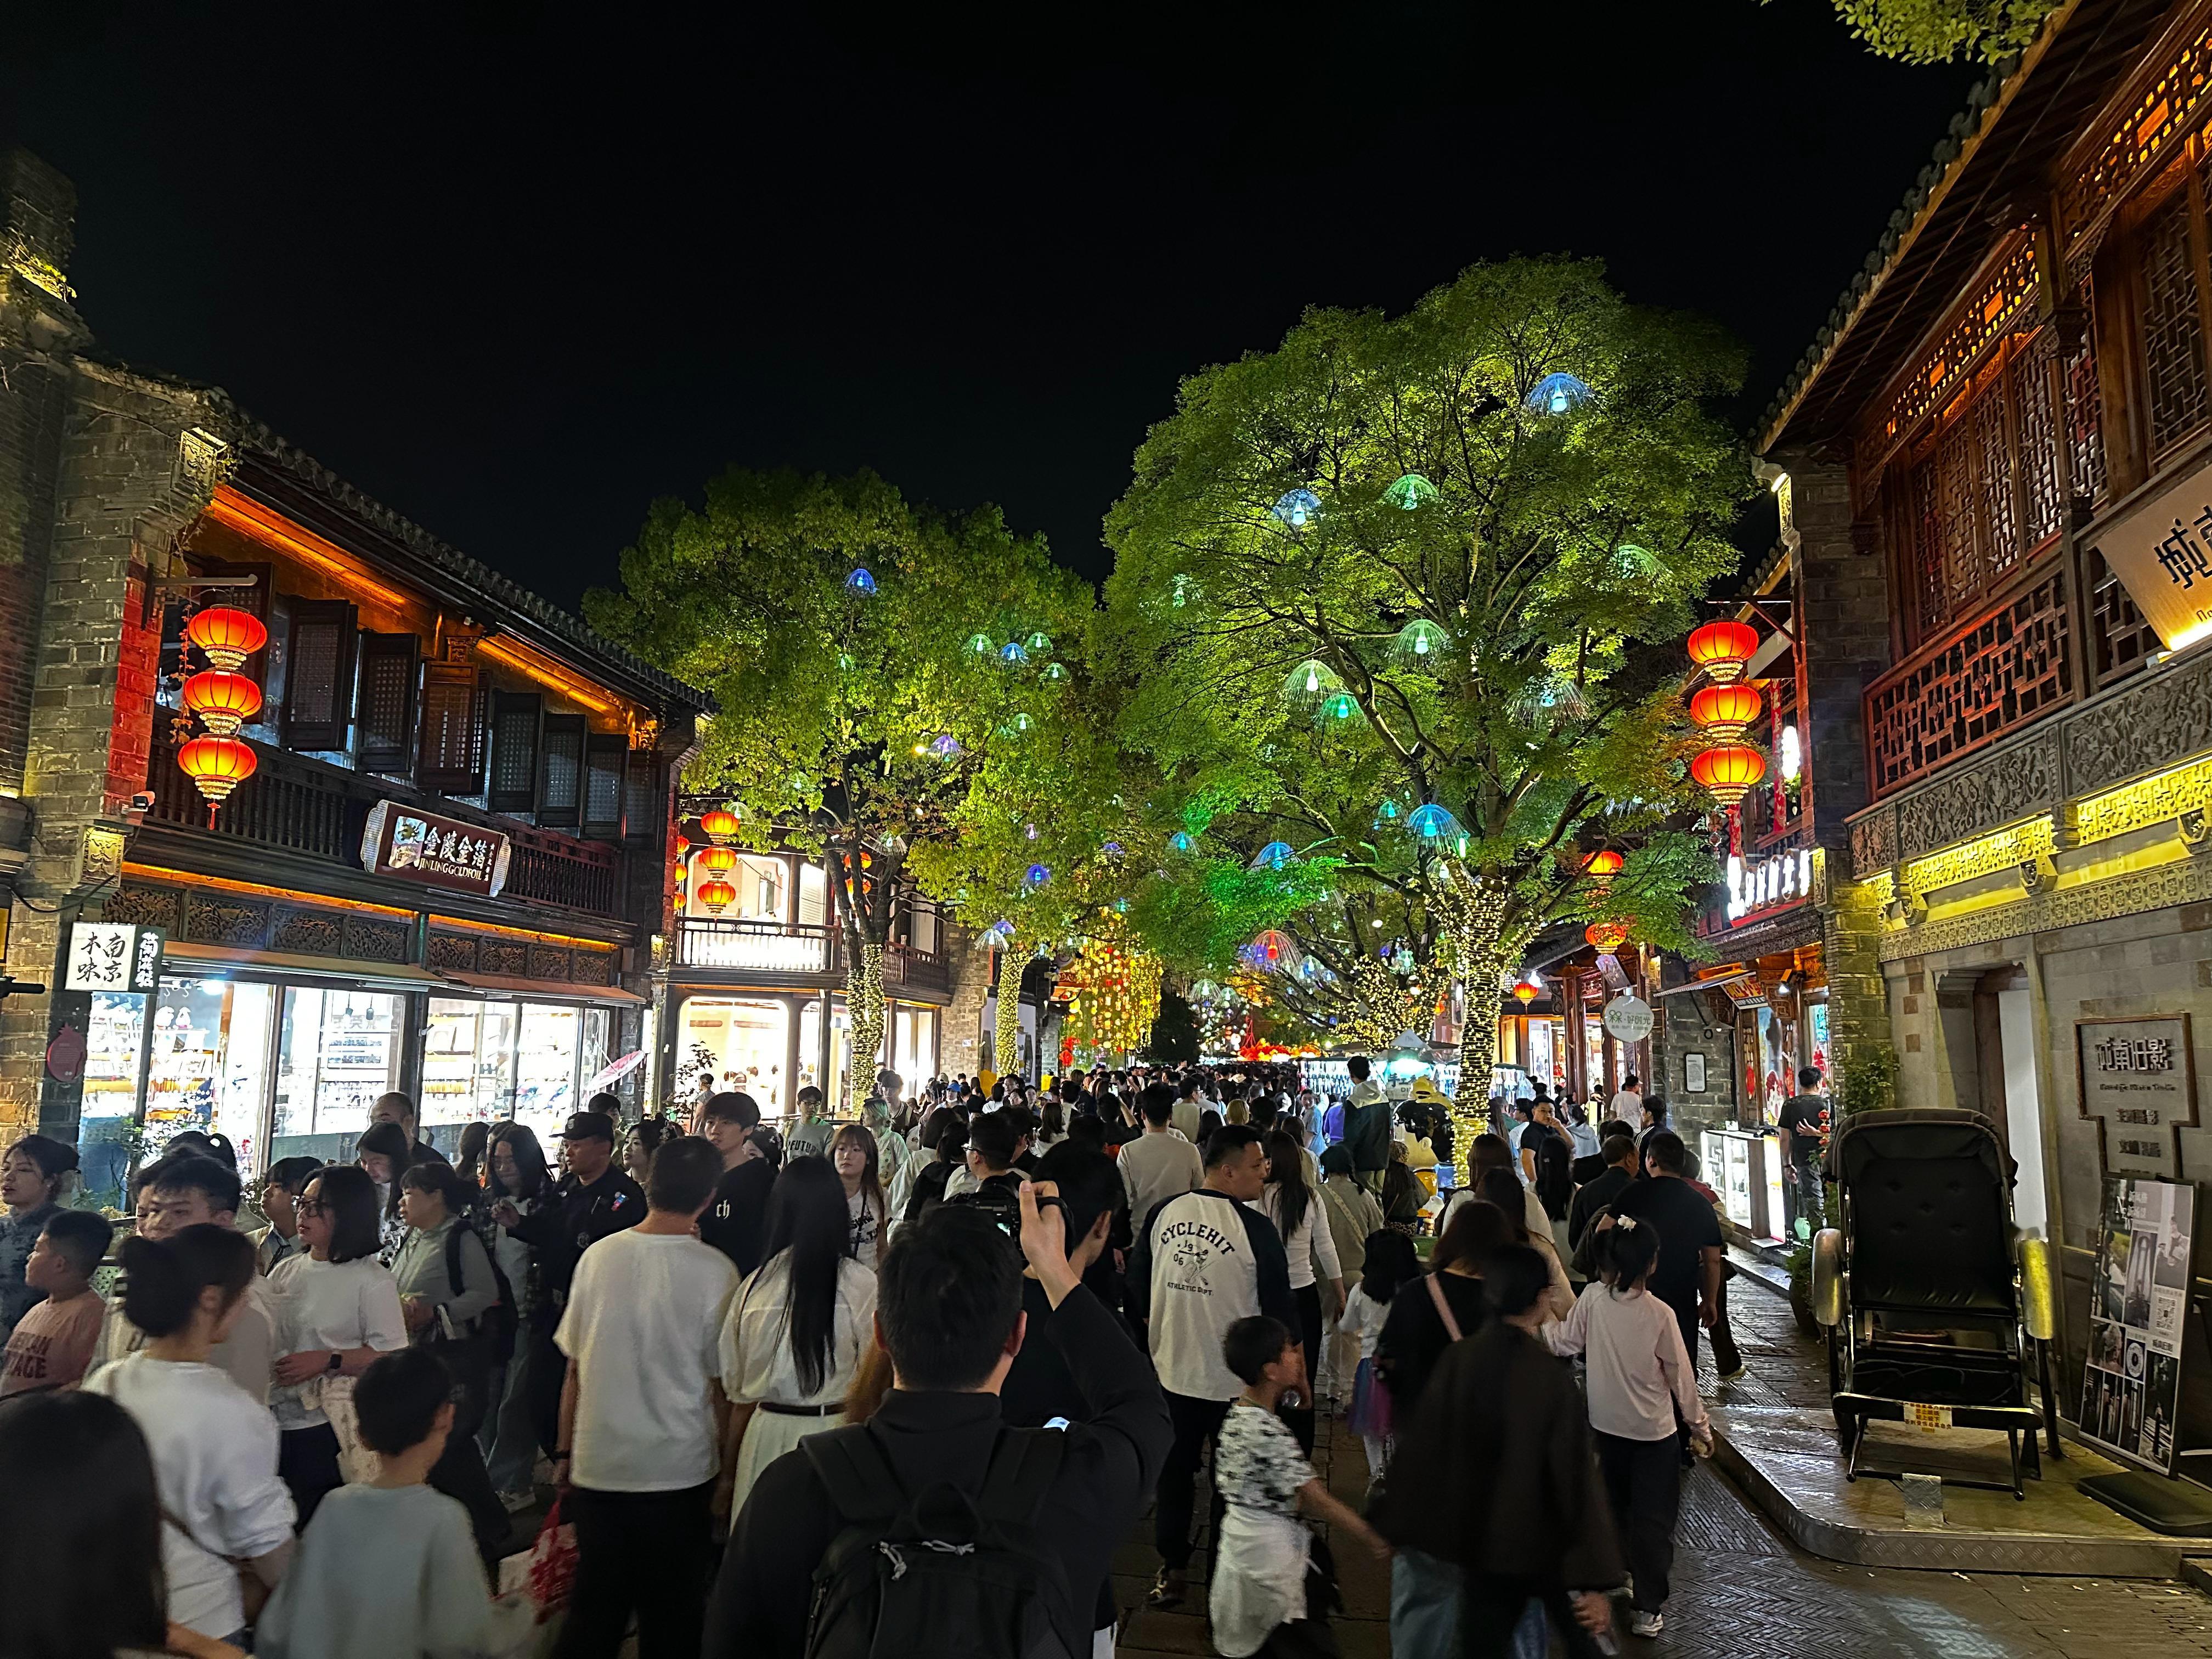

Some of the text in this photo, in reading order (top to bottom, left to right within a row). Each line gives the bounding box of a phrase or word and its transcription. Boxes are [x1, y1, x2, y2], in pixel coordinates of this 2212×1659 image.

[424, 826, 487, 870] 金陵金箔
[1161, 1222, 1235, 1255] CYCLEHIT
[1167, 1282, 1197, 1293] ATHLETIC
